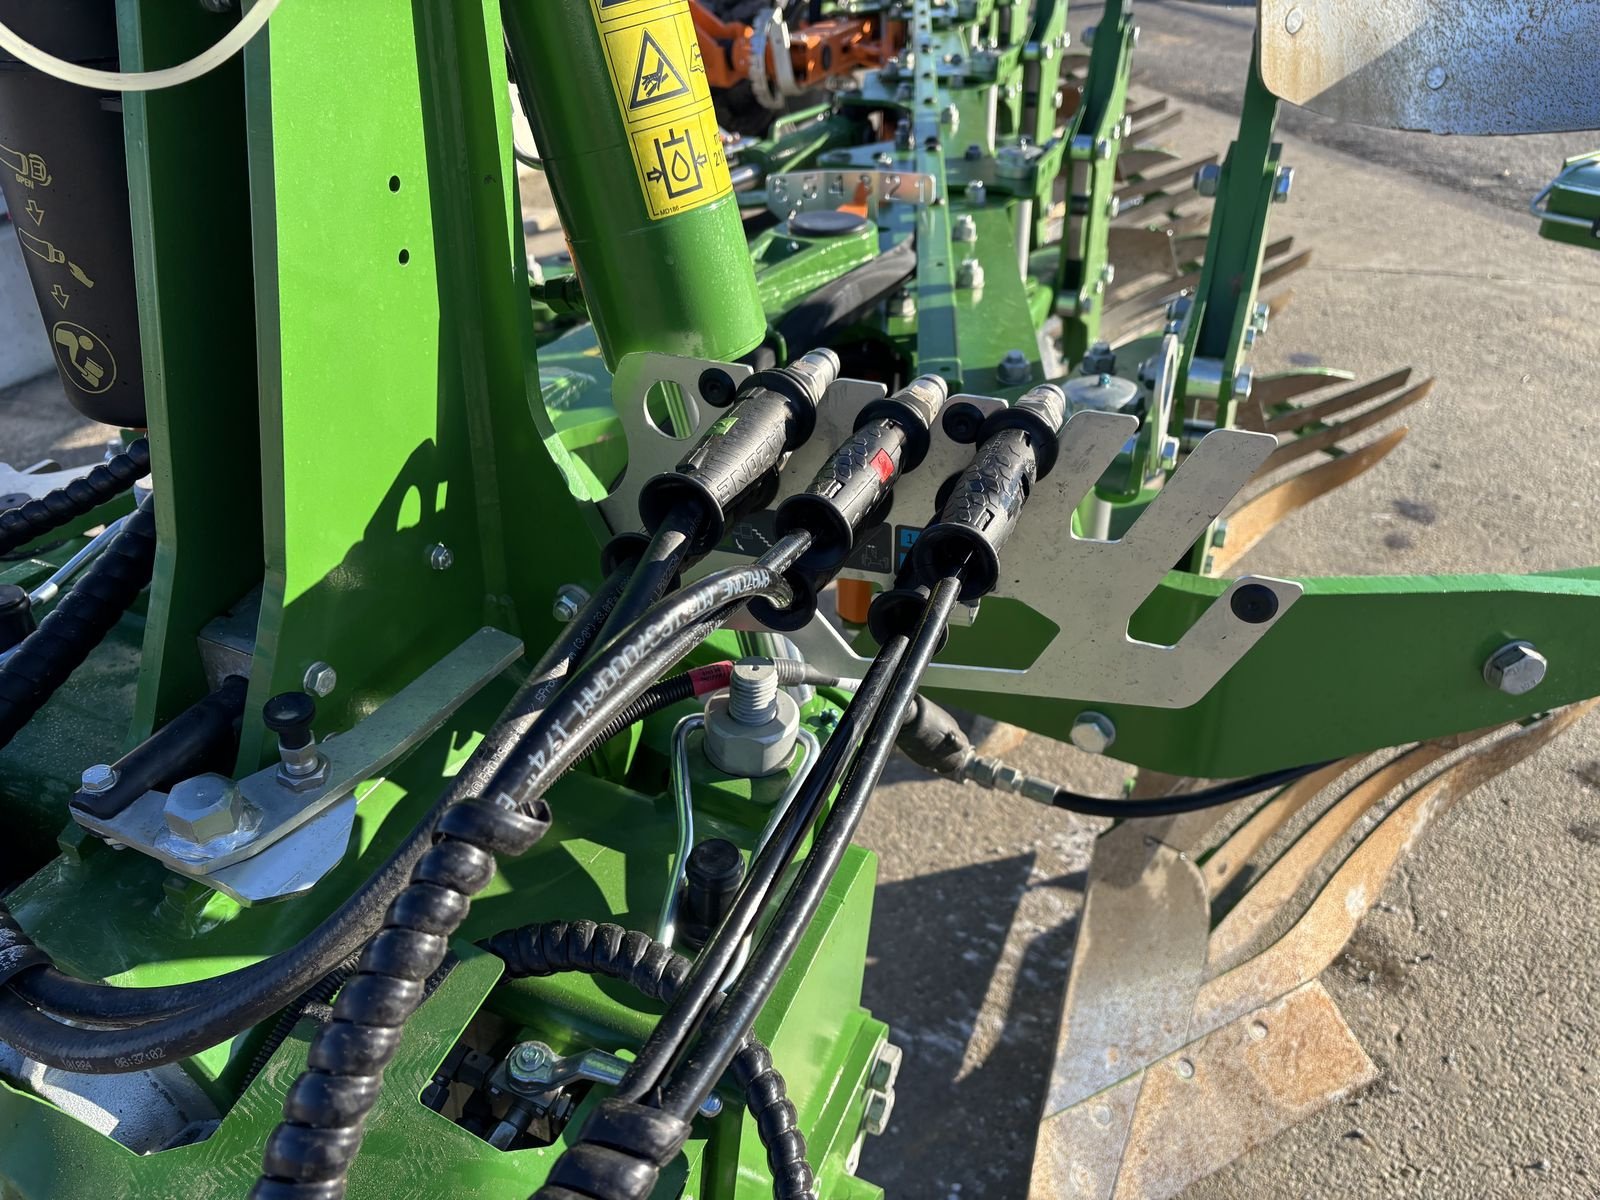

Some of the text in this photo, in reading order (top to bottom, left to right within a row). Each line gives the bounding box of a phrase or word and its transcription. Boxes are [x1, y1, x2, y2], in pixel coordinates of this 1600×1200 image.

[15, 173, 34, 188] OPEN
[885, 174, 901, 201] 2
[906, 533, 914, 544] 1
[718, 569, 770, 597] AMAZONE
[524, 717, 570, 786] 1/4"
[114, 1047, 166, 1068] 08:37:02
